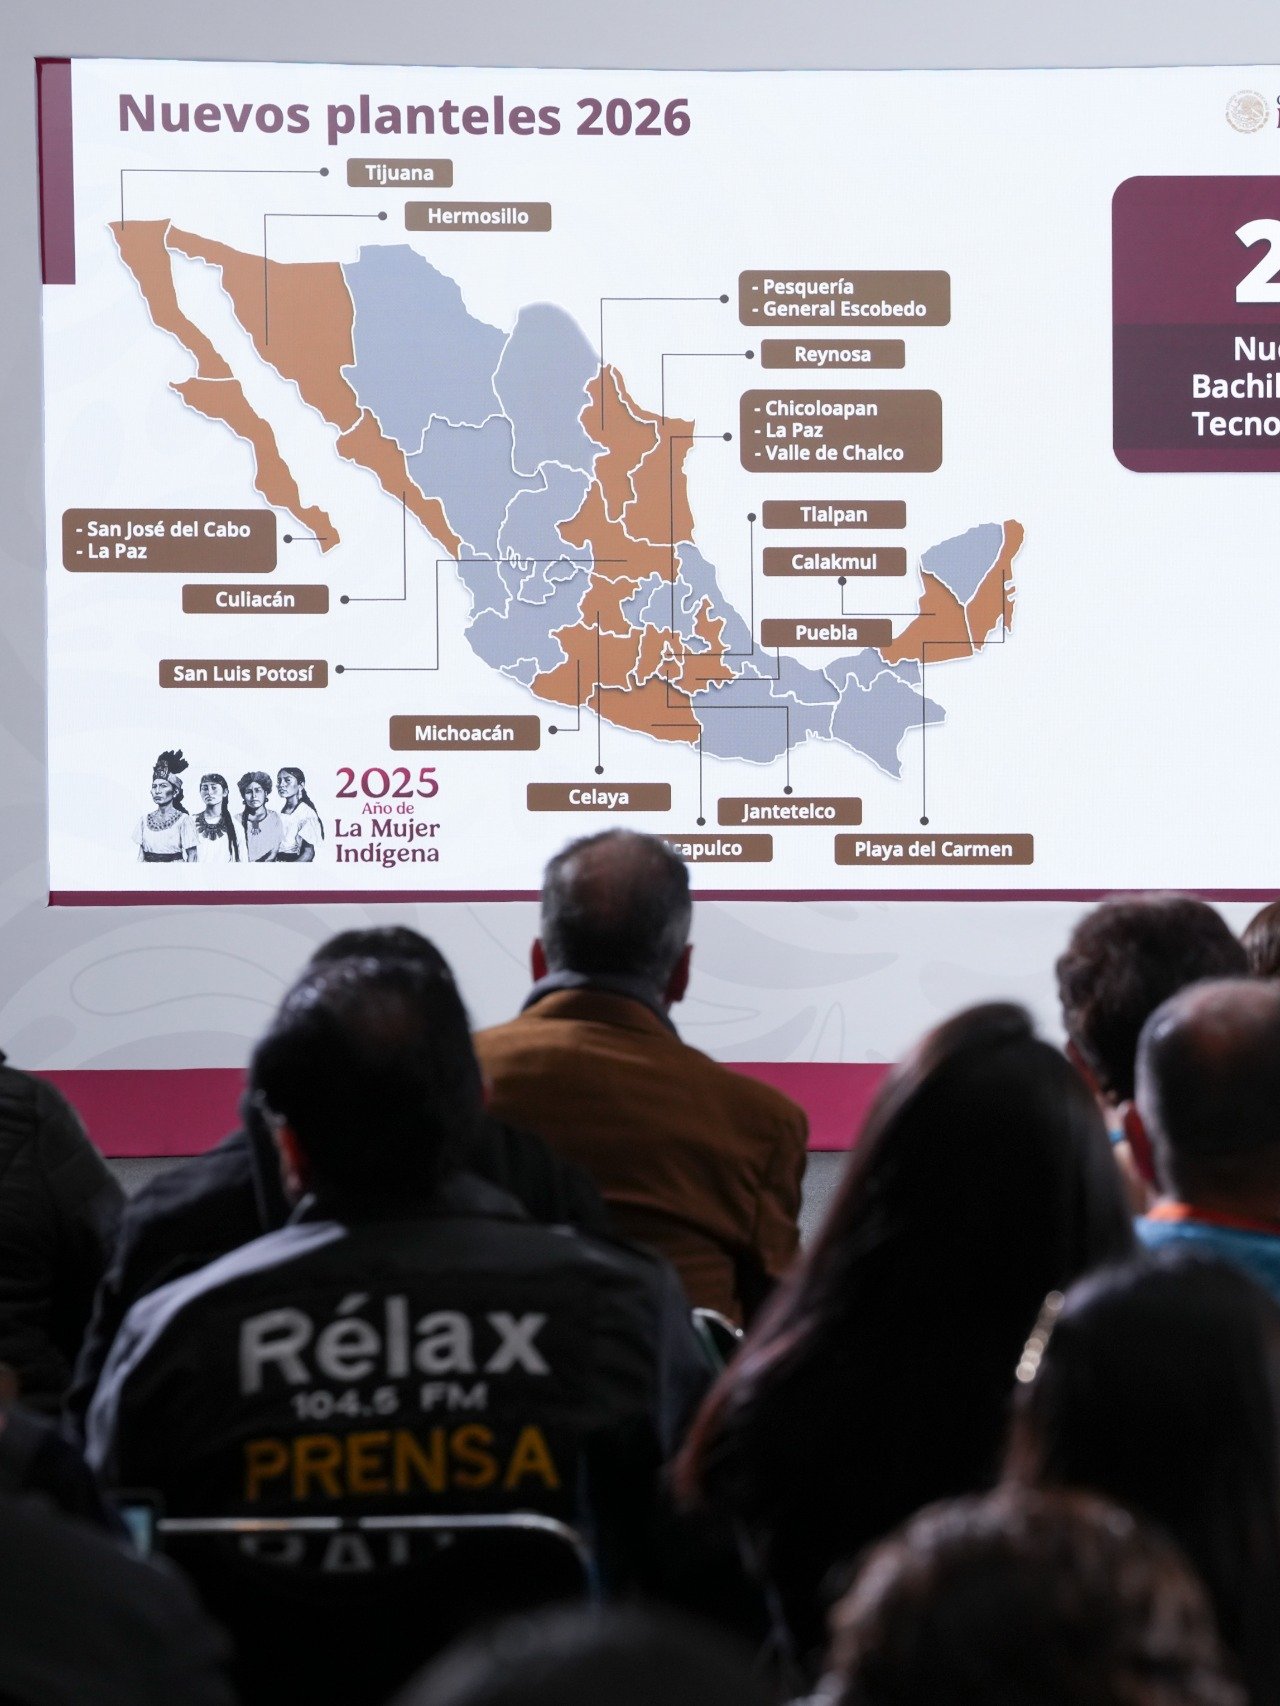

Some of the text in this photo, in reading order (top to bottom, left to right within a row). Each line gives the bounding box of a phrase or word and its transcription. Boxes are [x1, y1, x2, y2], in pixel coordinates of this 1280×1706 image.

[119, 93, 691, 146] Nuevos planteles 2026
[364, 164, 434, 185] Tijuana
[428, 207, 529, 225] Hermosillo
[763, 277, 854, 299] Pesquería
[763, 299, 835, 317] General
[840, 299, 927, 317] Escobedo
[795, 346, 872, 367] Reynosa
[765, 399, 878, 421] Chicoloapan
[766, 422, 787, 438] La
[792, 422, 824, 438] Paz
[764, 444, 811, 461] Valle
[815, 443, 839, 461] de
[842, 444, 904, 461] Chalco
[799, 506, 868, 529] Tlalpan
[87, 520, 122, 537] San
[124, 520, 165, 541] José
[170, 520, 199, 538] del
[203, 520, 251, 538] Cabo
[88, 542, 110, 559] La
[115, 542, 148, 559] Paz
[791, 552, 877, 570] Calakmul
[215, 590, 295, 608] Culiacán
[795, 623, 858, 641] Puebla
[173, 664, 315, 682] San Luis Potosí
[415, 724, 515, 741] Michoacán
[335, 766, 439, 799] 2025
[361, 801, 415, 815] Año de
[568, 788, 630, 810] Celaya
[741, 803, 837, 823] Jantetelco
[334, 817, 441, 845] La Mujer
[335, 843, 439, 869] Indígena
[855, 840, 1013, 862] Playa del Carmen
[239, 1293, 550, 1396] Rélax
[420, 1382, 487, 1409] FM
[245, 1424, 560, 1500] PRENSA
